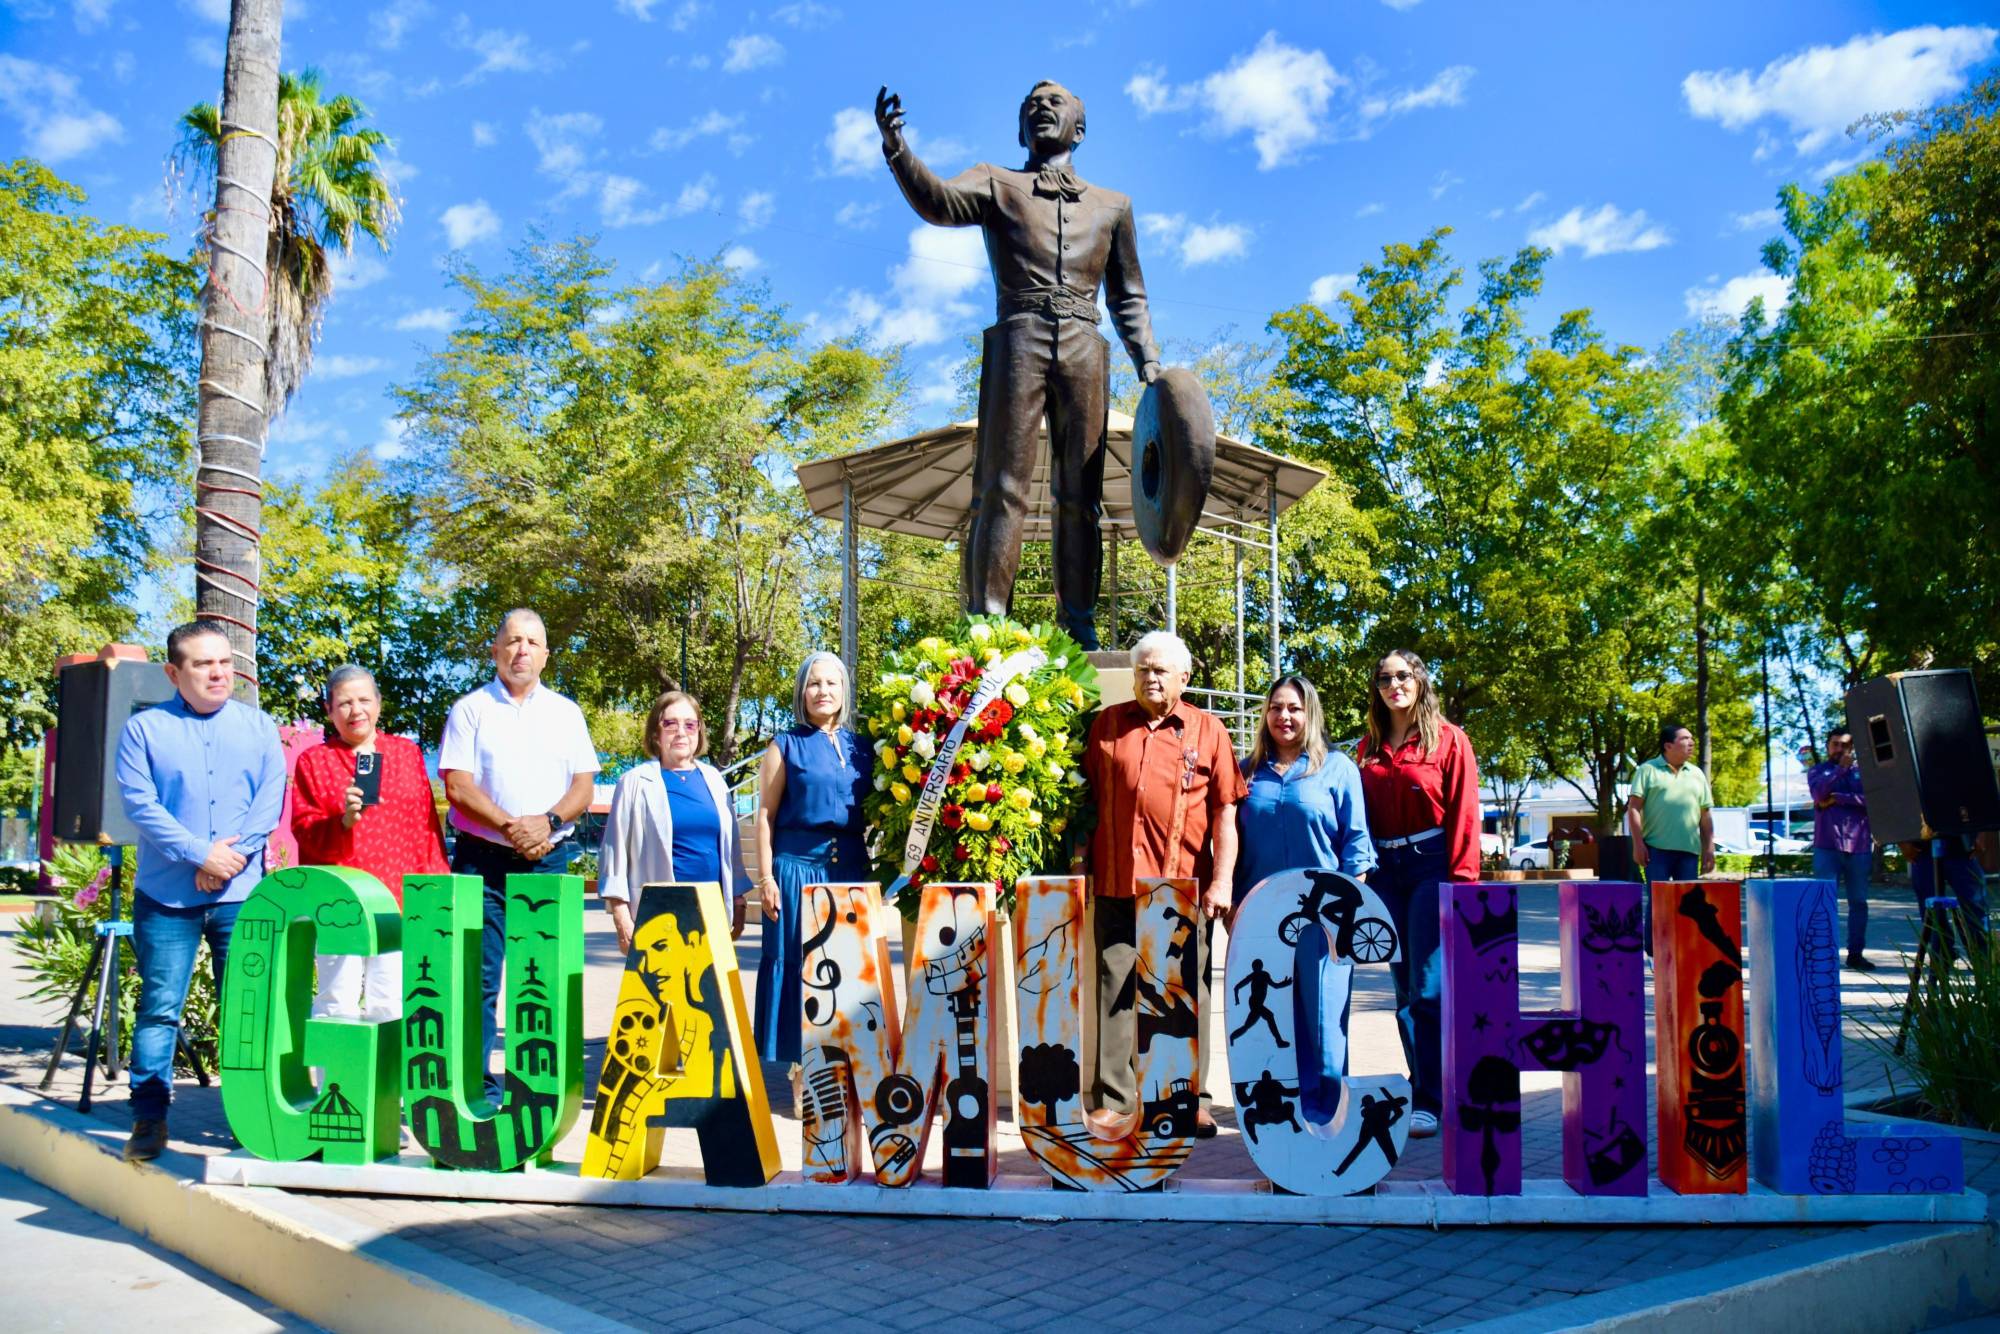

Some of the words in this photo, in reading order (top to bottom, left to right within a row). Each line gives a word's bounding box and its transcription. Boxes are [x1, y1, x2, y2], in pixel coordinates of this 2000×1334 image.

[914, 739, 957, 837] ANIVERSARIO
[907, 843, 922, 862] 69
[220, 866, 1963, 1196] GUAMUCHIL
